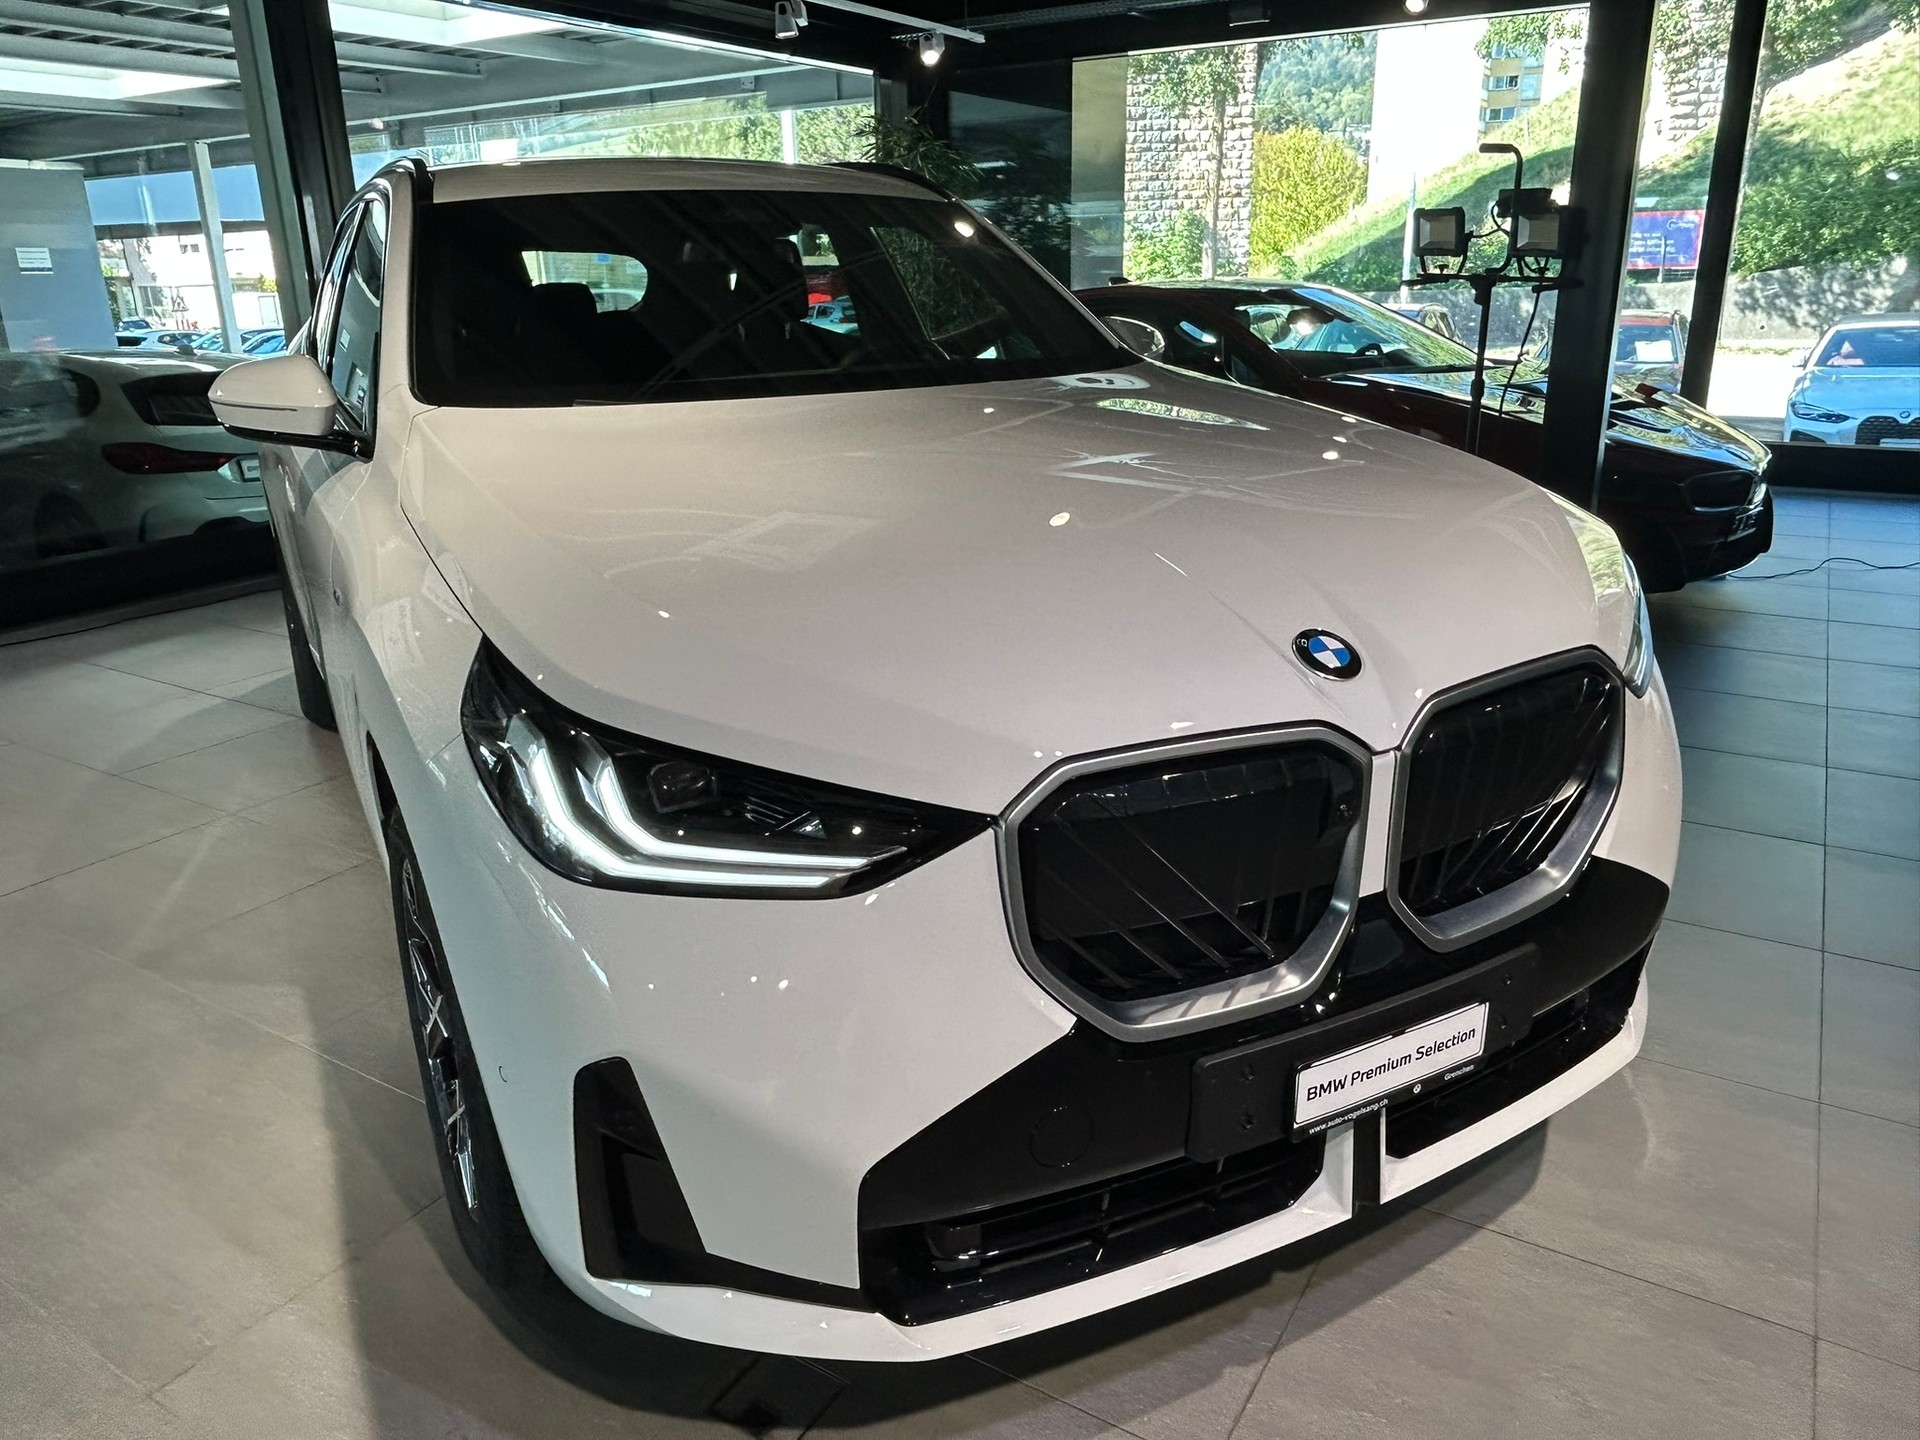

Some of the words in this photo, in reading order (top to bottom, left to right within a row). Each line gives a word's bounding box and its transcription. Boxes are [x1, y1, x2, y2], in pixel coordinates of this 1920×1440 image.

[1306, 1075, 1348, 1101] BMW
[1350, 1055, 1412, 1086] Premium
[1415, 1027, 1476, 1061] Selection
[1308, 1098, 1389, 1135] www.auto-vogelsang.ch
